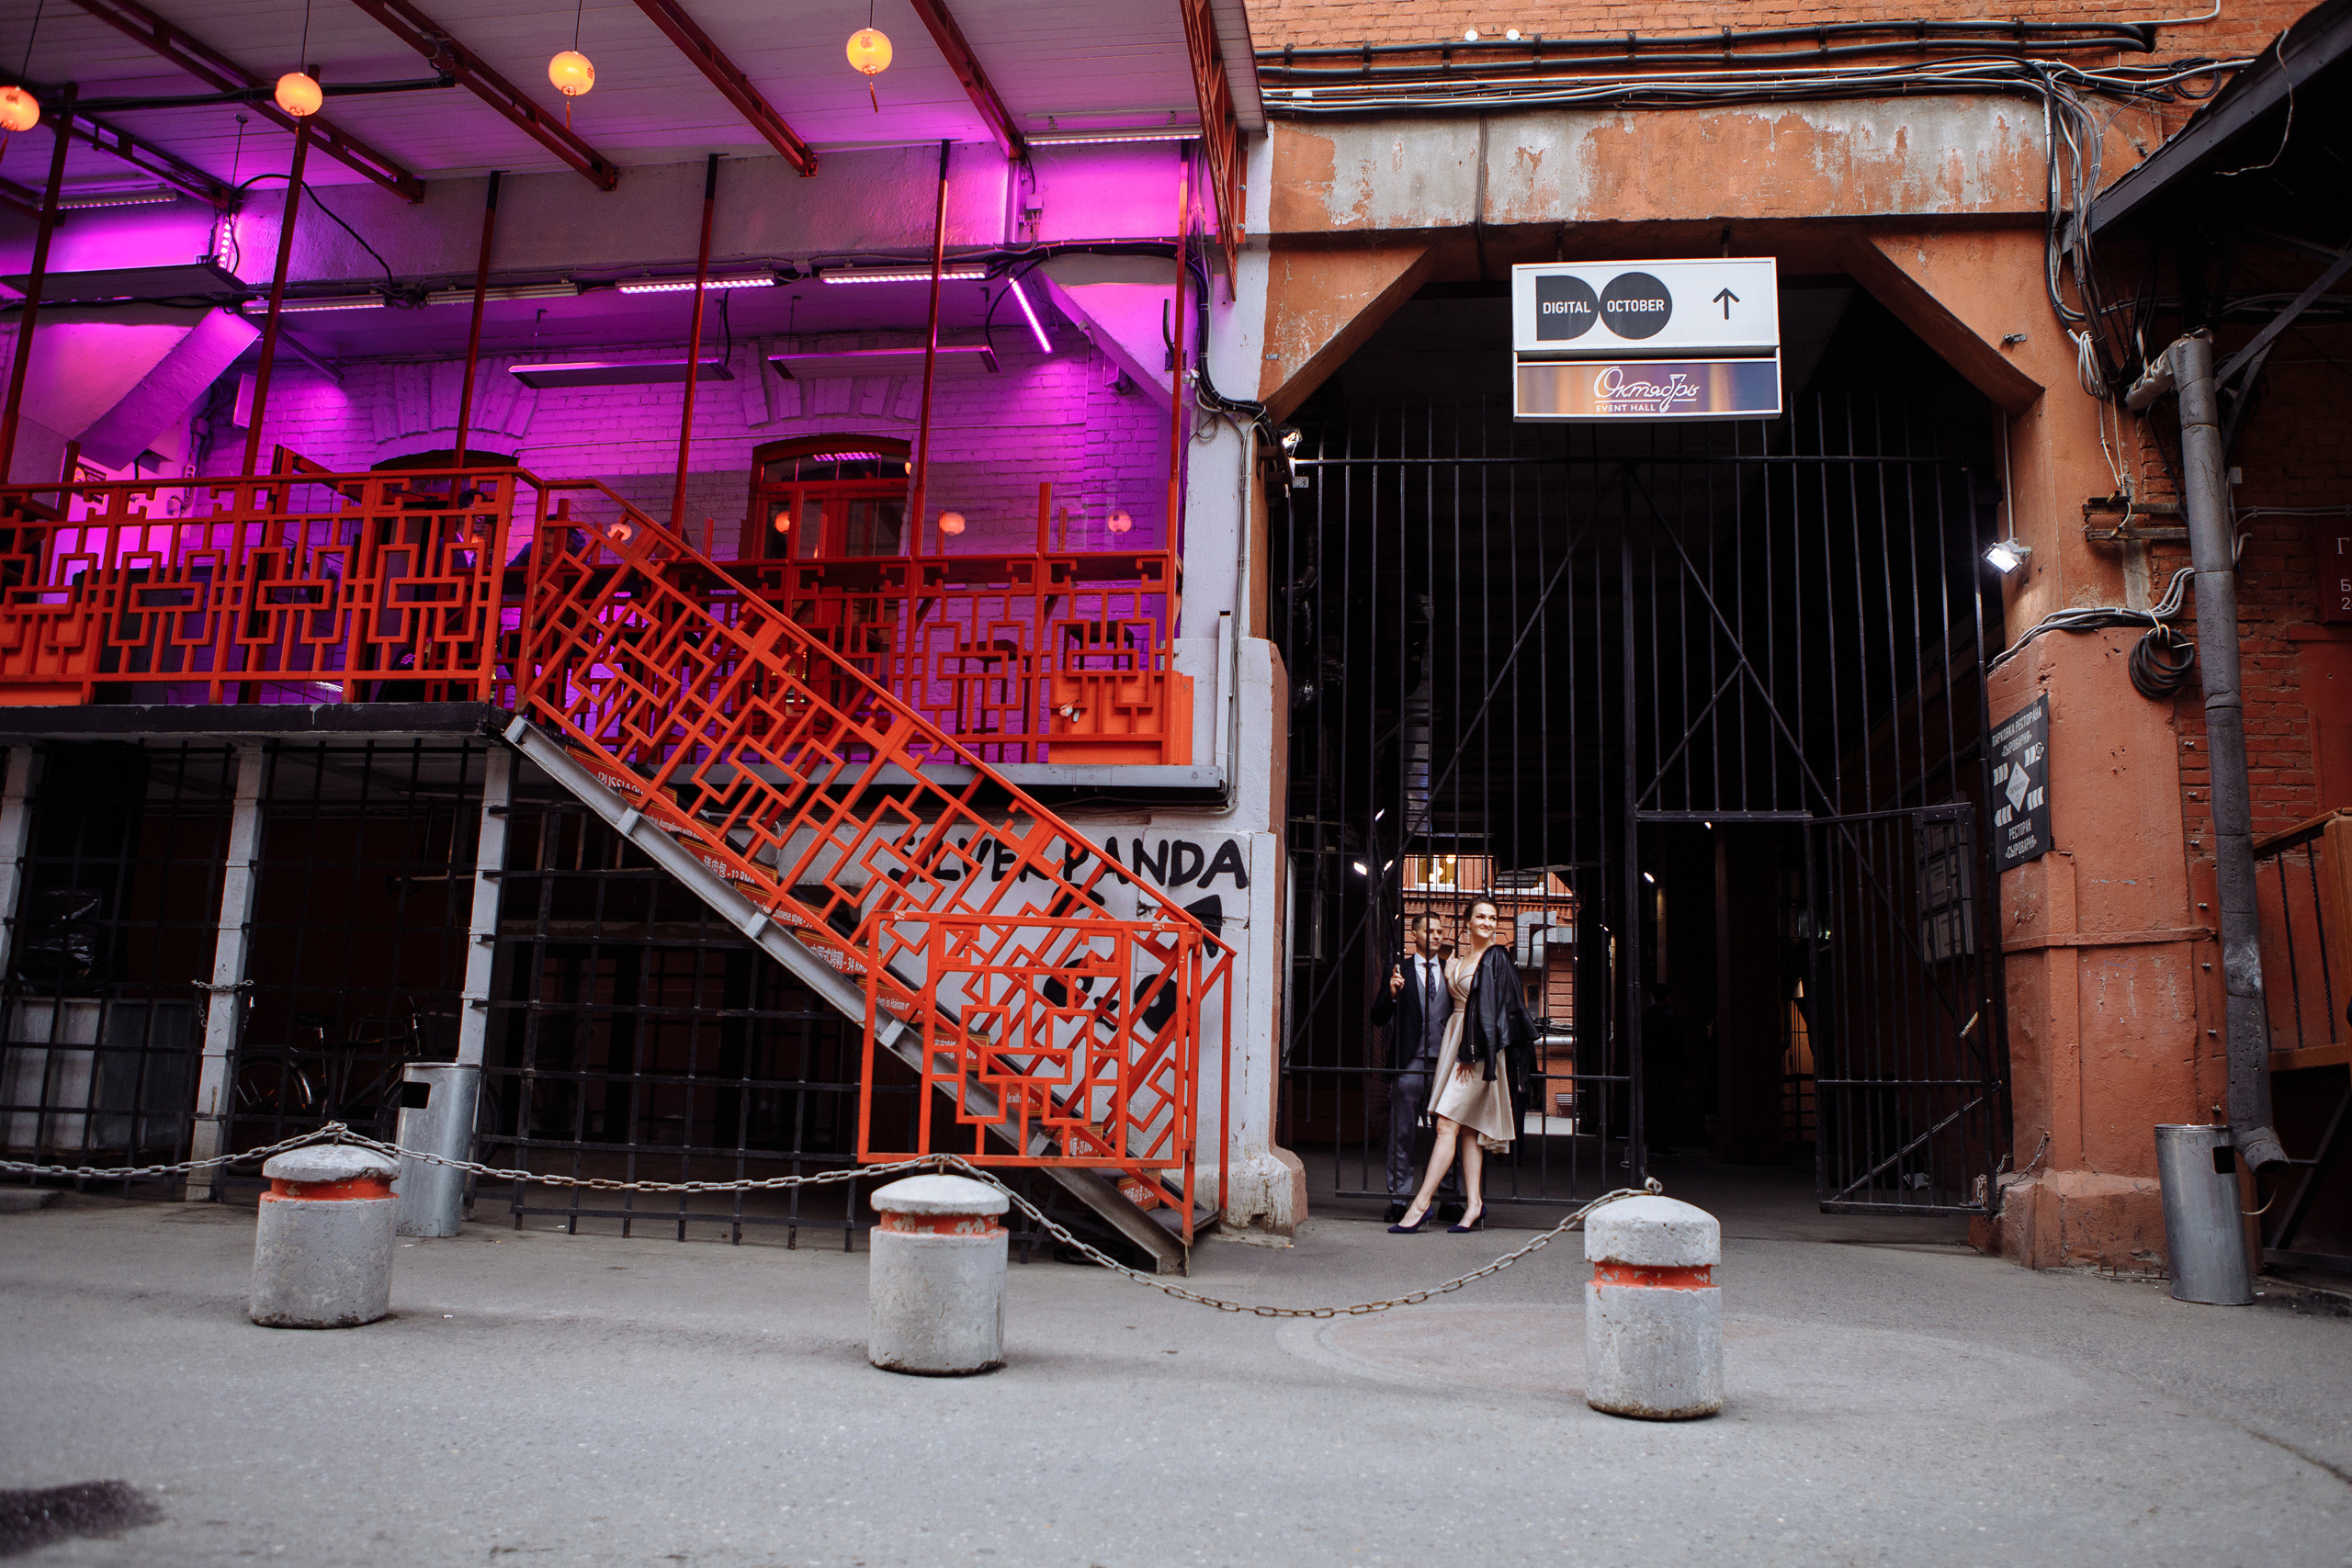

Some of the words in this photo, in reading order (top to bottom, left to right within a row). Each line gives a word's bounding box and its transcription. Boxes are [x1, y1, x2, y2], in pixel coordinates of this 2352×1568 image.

[1543, 300, 1591, 314] DIGITAL
[1607, 299, 1665, 312] OCTOBER
[1593, 366, 1700, 413] Октябрь
[1596, 404, 1627, 412] EVENT
[1630, 403, 1657, 412] HALL
[1992, 722, 2016, 748] ПАРКОВКА
[2015, 705, 2042, 733] РЕСТОРАНА
[2008, 818, 2032, 841] РЕСТОРАН
[1063, 836, 1250, 890] PANDA
